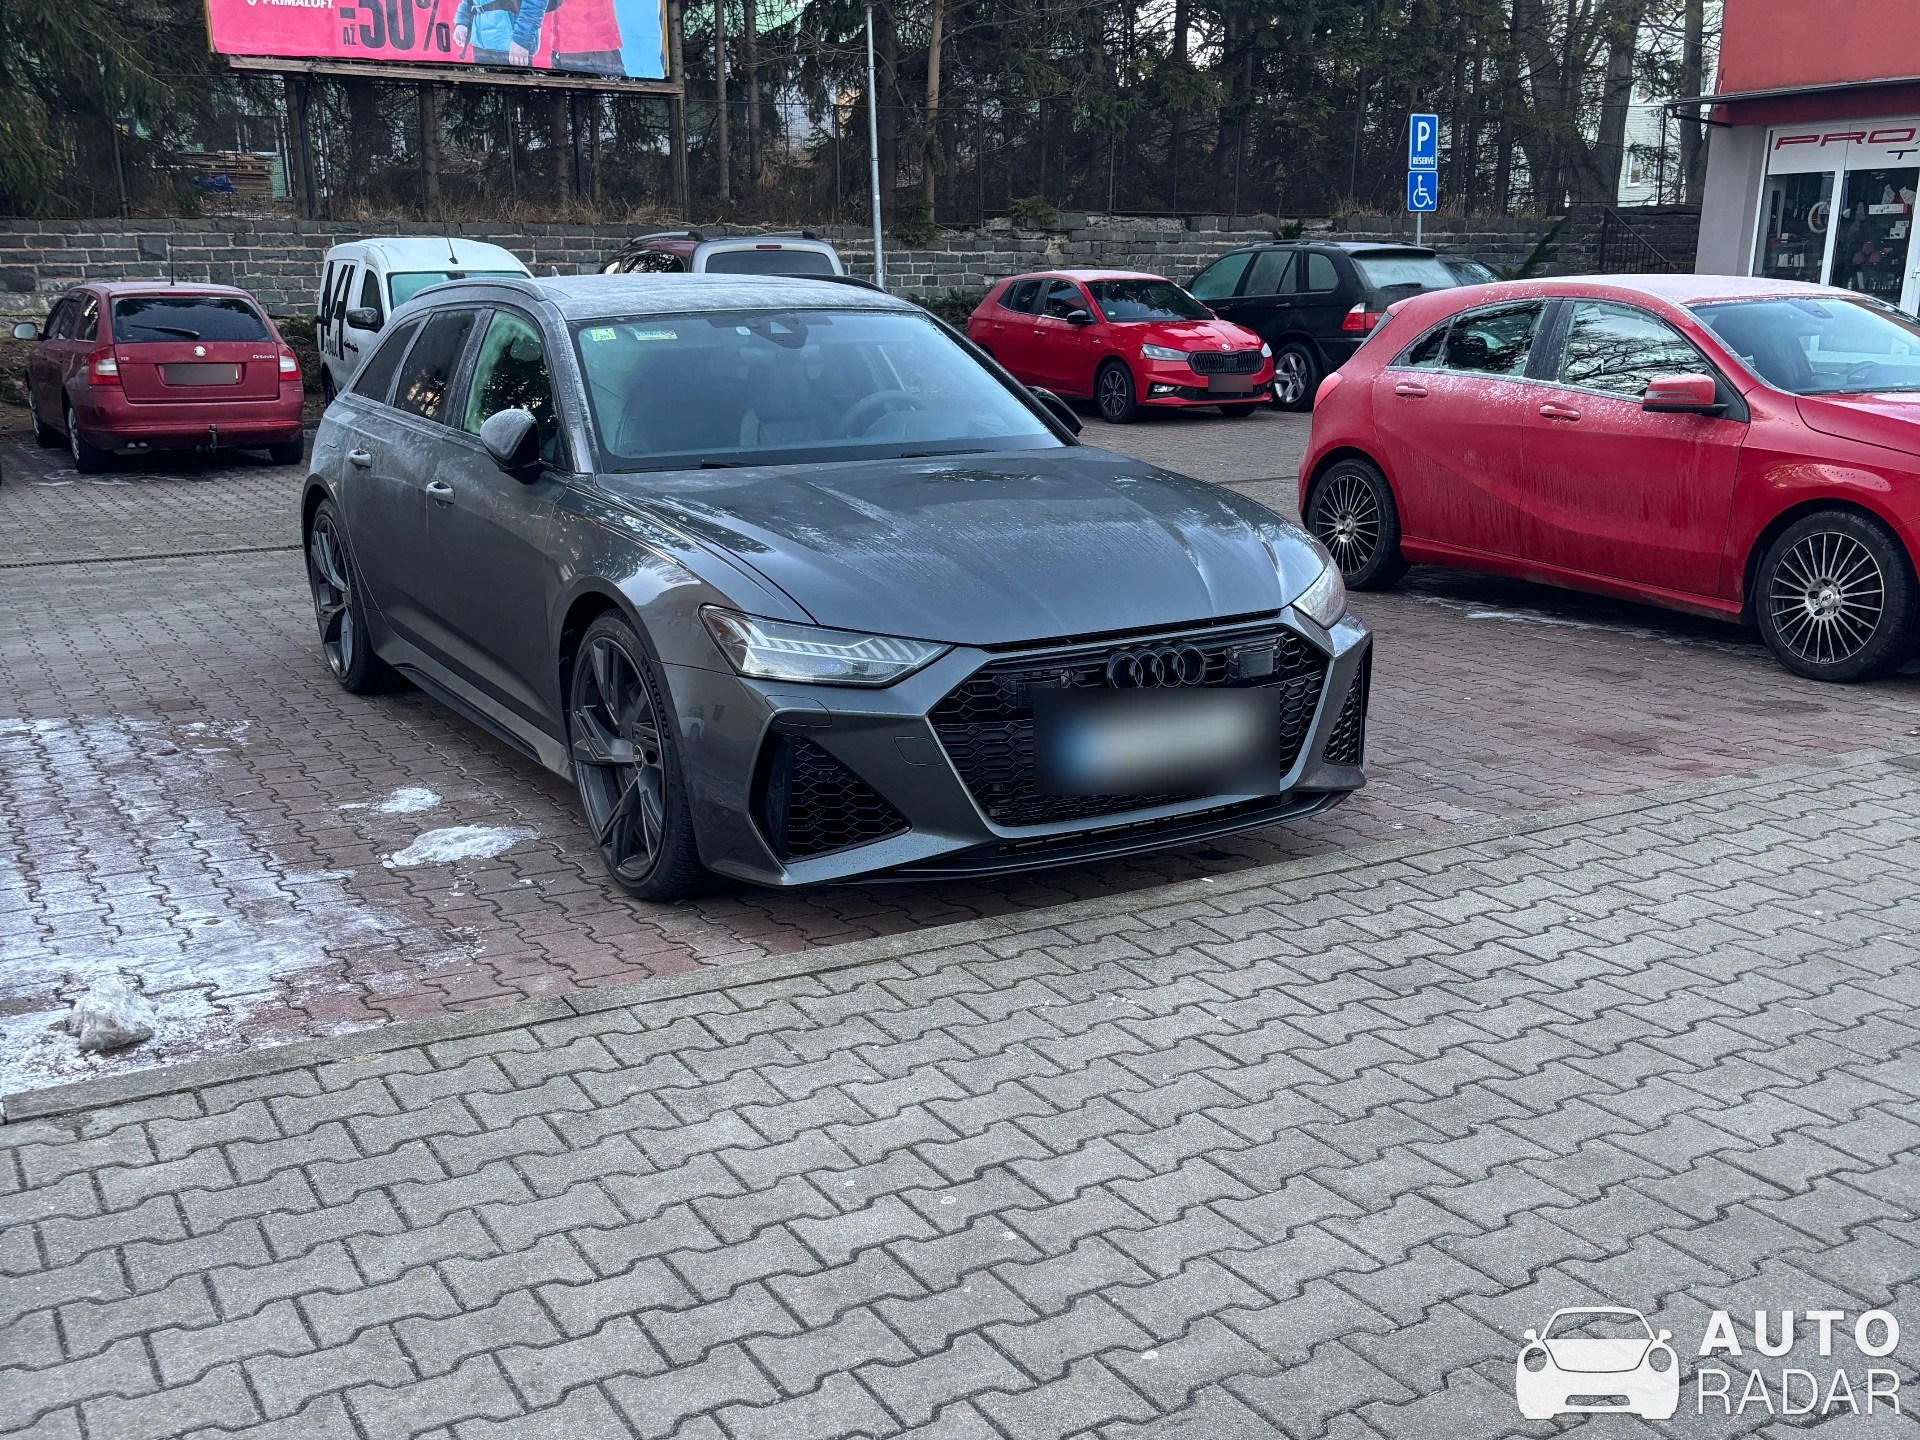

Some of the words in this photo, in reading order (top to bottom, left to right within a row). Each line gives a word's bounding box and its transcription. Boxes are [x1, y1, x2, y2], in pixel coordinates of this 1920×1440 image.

[343, 24, 356, 45] AŽ
[1417, 121, 1430, 152] P
[1774, 127, 1917, 150] PRO
